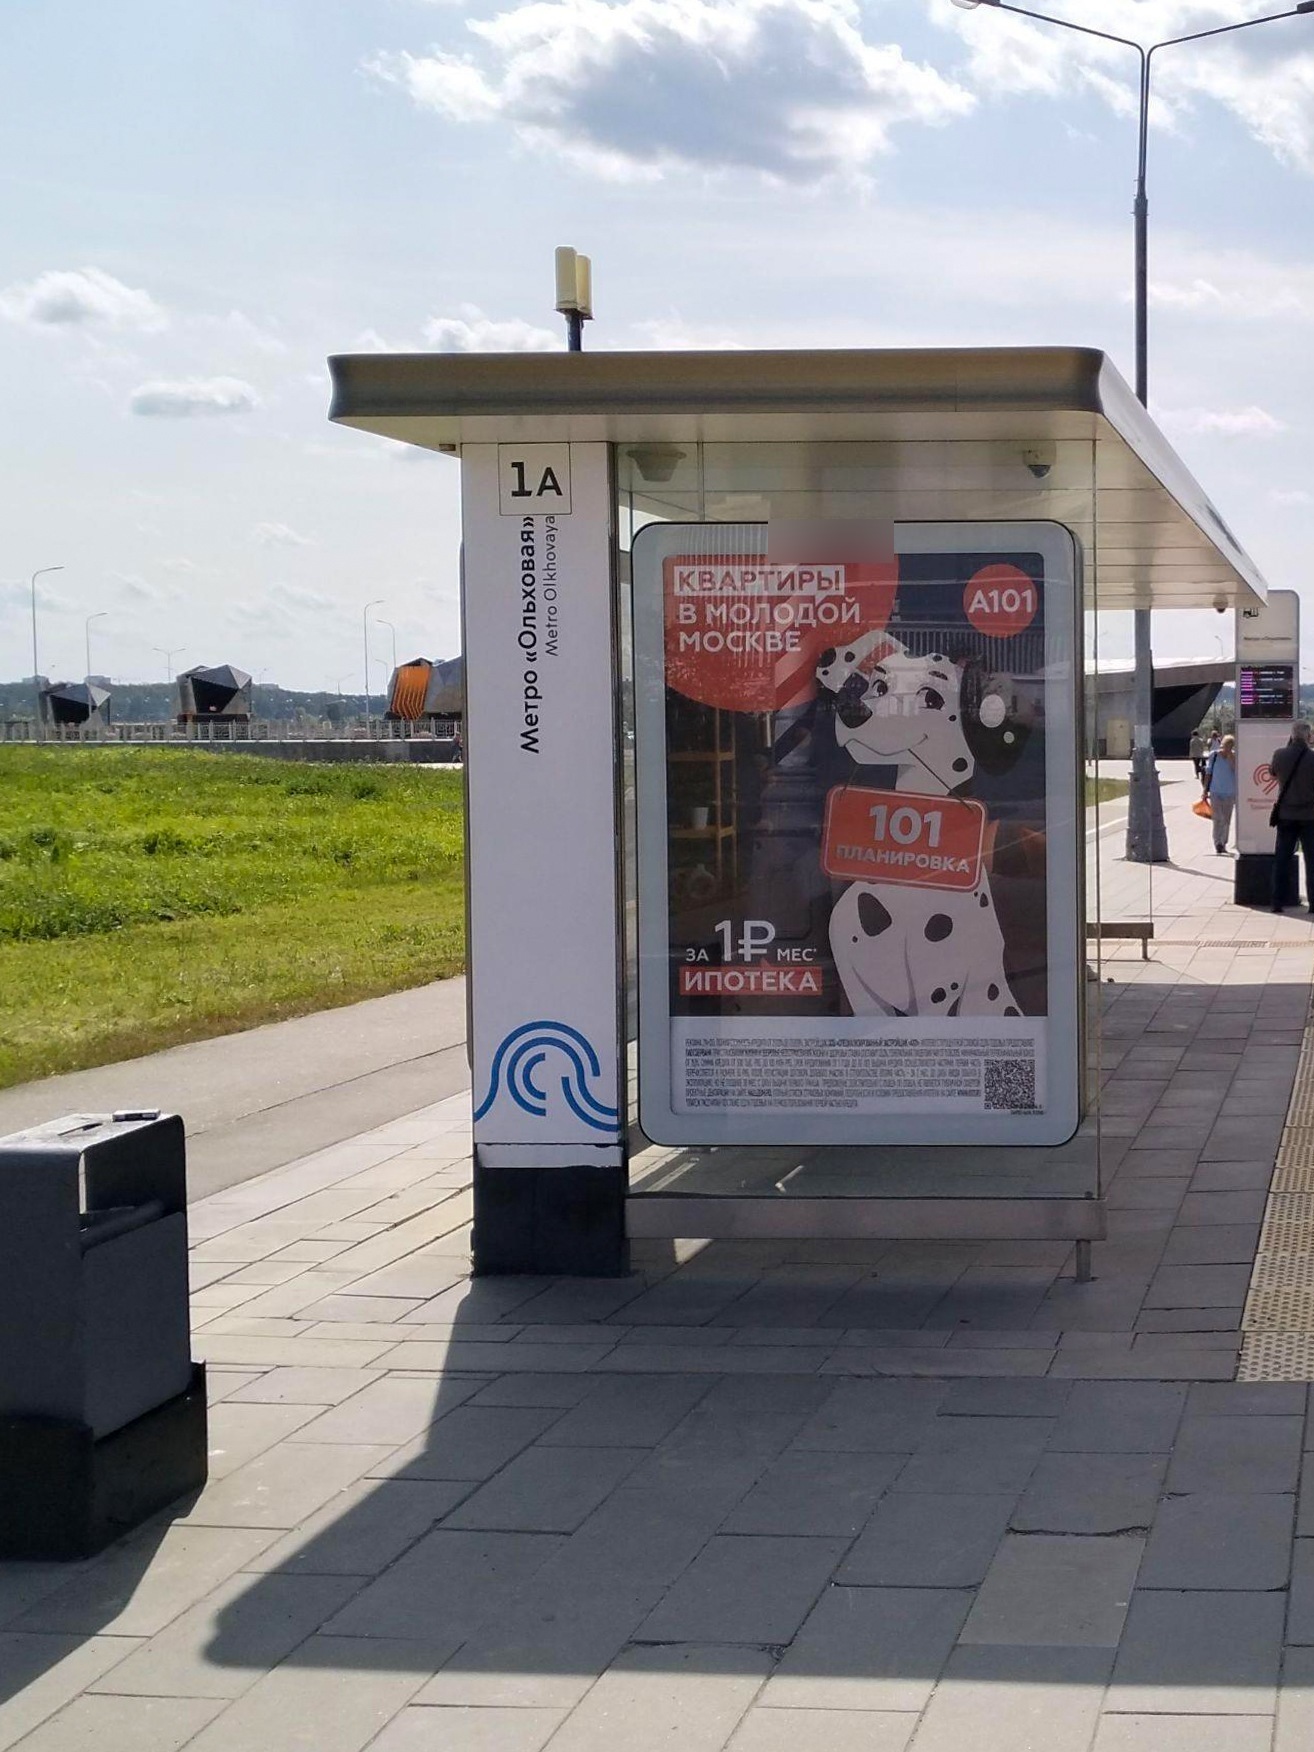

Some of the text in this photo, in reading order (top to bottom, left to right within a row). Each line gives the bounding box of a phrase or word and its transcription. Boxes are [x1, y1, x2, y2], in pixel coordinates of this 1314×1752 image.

[511, 461, 563, 497] 1А
[542, 515, 559, 656] Metro Olkhovaya
[679, 570, 840, 592] КВАРТИРЫ
[679, 597, 861, 627] В МОЛОДОЙ
[968, 588, 1033, 613] А101
[518, 516, 543, 754] Метро «Ольховая»
[679, 631, 802, 652] МОСКВЕ
[869, 804, 943, 848] 101
[836, 845, 970, 873] ПЛАНИРОВКА
[685, 948, 709, 962] ЗА
[685, 971, 818, 992] ИПОТЕКА
